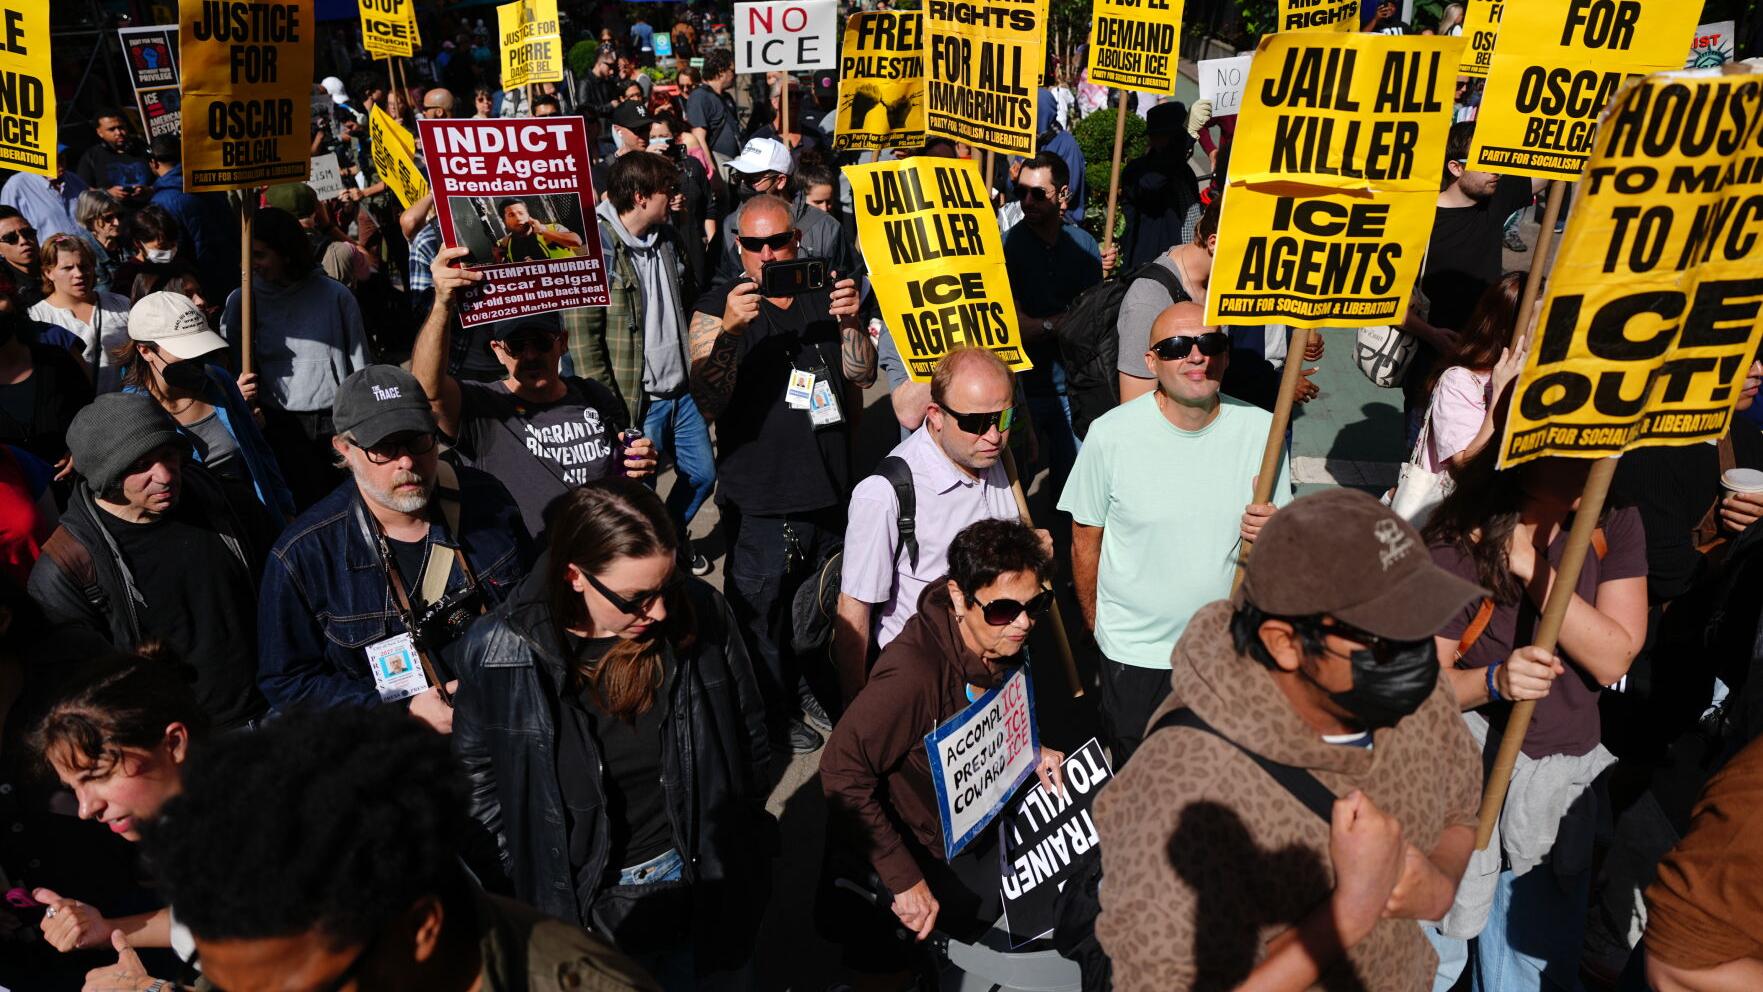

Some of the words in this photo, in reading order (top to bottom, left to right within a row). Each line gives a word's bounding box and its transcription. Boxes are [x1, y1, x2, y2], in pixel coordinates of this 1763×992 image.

[0, 8, 27, 56] E
[193, 0, 299, 43] JUSTICE
[366, 18, 407, 39] ICE
[537, 20, 556, 35] FOR
[748, 6, 808, 35] NO
[929, 1, 1035, 31] RIGHTS
[1285, 1, 1358, 30] RIGHTS
[1560, 0, 1641, 50] FOR
[746, 35, 821, 68] ICE
[1096, 17, 1174, 54] DEMAND
[230, 45, 277, 84] FOR
[509, 42, 552, 67] PIERRE
[932, 34, 972, 87] FOR
[979, 41, 1028, 96] ALL
[1097, 48, 1142, 72] ABOLISH
[1145, 54, 1168, 76] ICE!
[1217, 67, 1241, 87] NO
[1261, 47, 1361, 112] JAIL
[1373, 50, 1441, 113] ALL
[1515, 65, 1646, 119] OSCA
[144, 92, 159, 105] ICE
[928, 81, 1032, 130] IMMIGRANTS
[1214, 90, 1239, 111] ICE
[208, 98, 294, 141] OSCAR
[930, 116, 948, 131] PARTY
[947, 119, 958, 133] FOR
[958, 121, 984, 140] SOCIALISM
[991, 131, 1029, 148] LIBERATION
[222, 138, 281, 166] BELGAL
[433, 125, 573, 153] INDICT
[1269, 115, 1419, 180] KILLER
[194, 171, 217, 184] PARTY
[218, 171, 232, 182] FOR
[439, 156, 488, 175] ICE
[496, 154, 577, 178] Agent
[1482, 149, 1511, 163] PARTY
[1512, 152, 1530, 165] FOR
[1531, 154, 1581, 171] SOCIALISM
[444, 177, 527, 192] Brendan
[533, 175, 578, 190] Cuni
[865, 167, 935, 217] JAIL
[934, 166, 985, 209] ALL
[1588, 166, 1659, 195] TO
[1272, 197, 1390, 237] ICE
[883, 213, 985, 265] KILLER
[1602, 205, 1674, 273] TO
[481, 263, 547, 281] TTEMPTED
[549, 258, 600, 274] MURDER
[483, 278, 536, 295] Oscar
[541, 272, 598, 288] Belgal
[1235, 236, 1402, 296] AGENTS
[463, 298, 504, 312] 5-yr-old
[505, 294, 524, 304] son
[525, 291, 535, 301] in
[537, 288, 554, 299] the
[555, 286, 580, 297] back
[581, 284, 604, 294] seat
[906, 272, 987, 309] ICE
[1221, 299, 1254, 312] PARTY
[1256, 298, 1277, 312] FOR
[1277, 298, 1331, 316] SOCIALISM
[1332, 304, 1341, 315] &
[1343, 301, 1397, 315] LIBERATION
[465, 307, 518, 324] 10/8/2026
[521, 302, 559, 313] Marble
[561, 298, 580, 307] Hill
[582, 295, 607, 304] NYC
[1537, 278, 1763, 366] ICE
[901, 301, 1010, 357] AGENTS
[912, 361, 930, 373] PARTY
[373, 387, 402, 401] TRACE
[1520, 353, 1745, 421] OUT!
[1549, 427, 1577, 445] FOR
[1652, 410, 1726, 433] LIBERATION
[947, 674, 1022, 767] ACCOMPLICE
[954, 703, 1027, 790] PREJUDICE
[954, 724, 1029, 814] COWARDICE
[1066, 747, 1108, 795] TO
[1019, 785, 1073, 834] KILL
[1001, 808, 1100, 900] TRAINED
